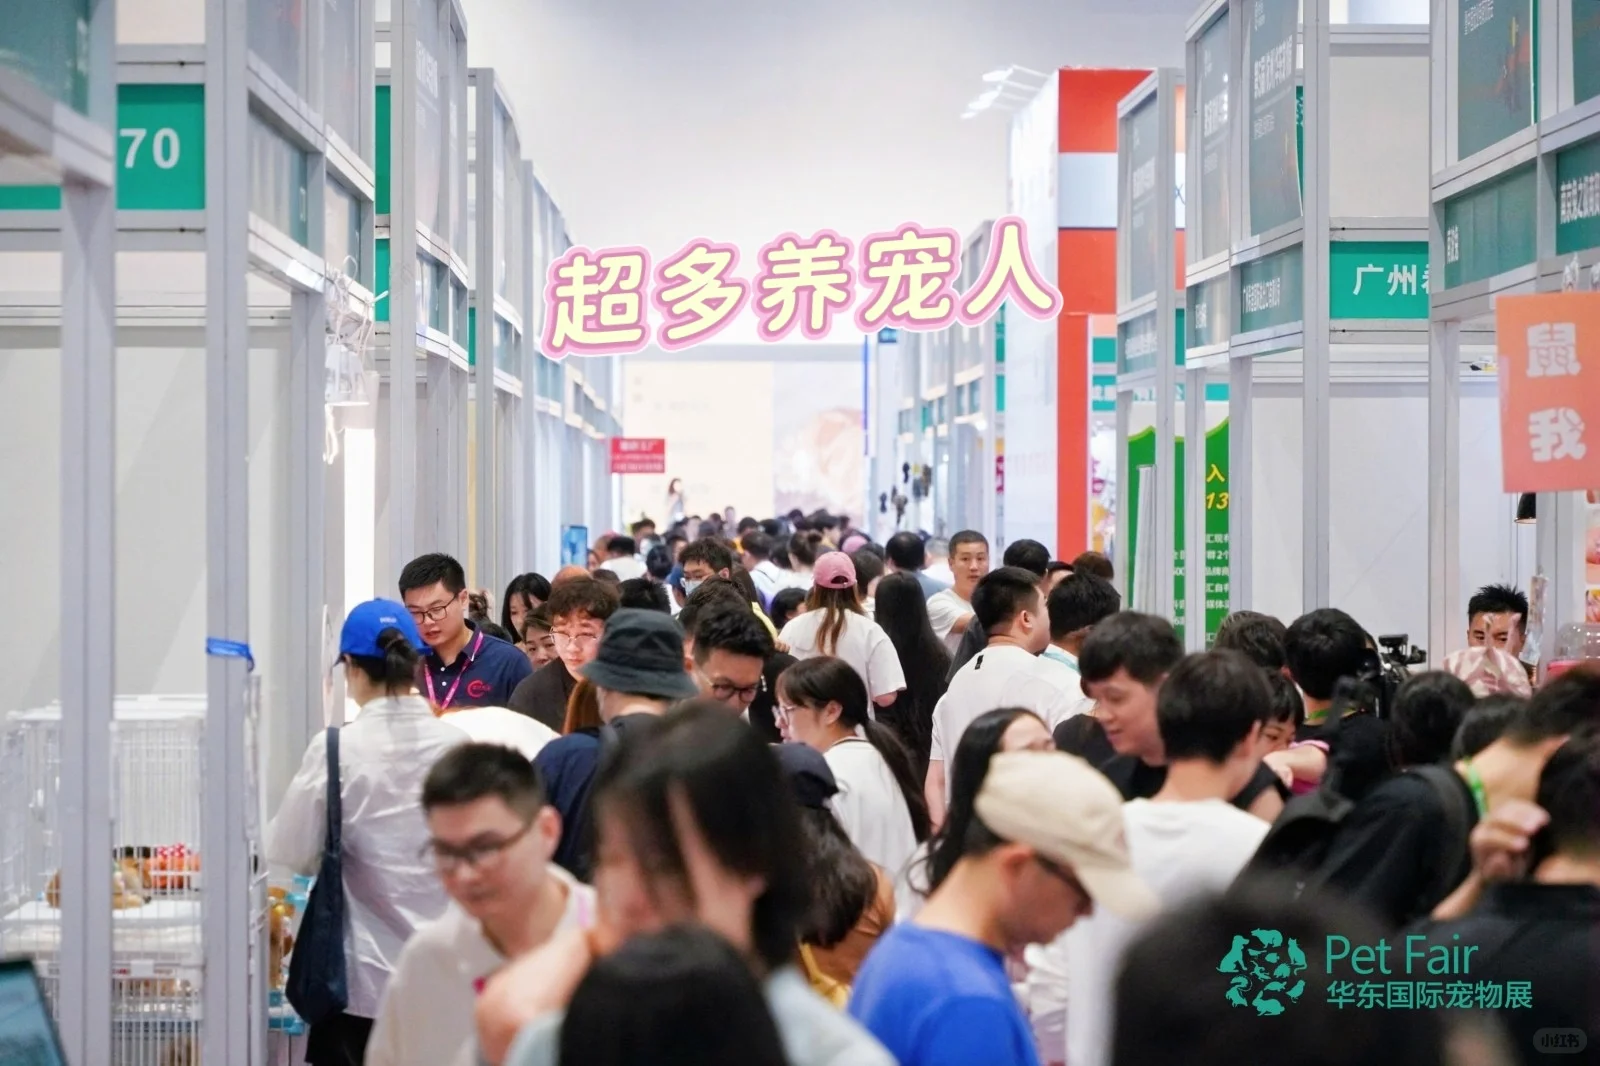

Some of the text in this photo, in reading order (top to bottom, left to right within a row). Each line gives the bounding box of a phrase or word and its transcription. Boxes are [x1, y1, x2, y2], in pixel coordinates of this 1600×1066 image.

[120, 127, 180, 169] 70
[1352, 263, 1429, 296] 广州
[1529, 407, 1586, 463] 我
